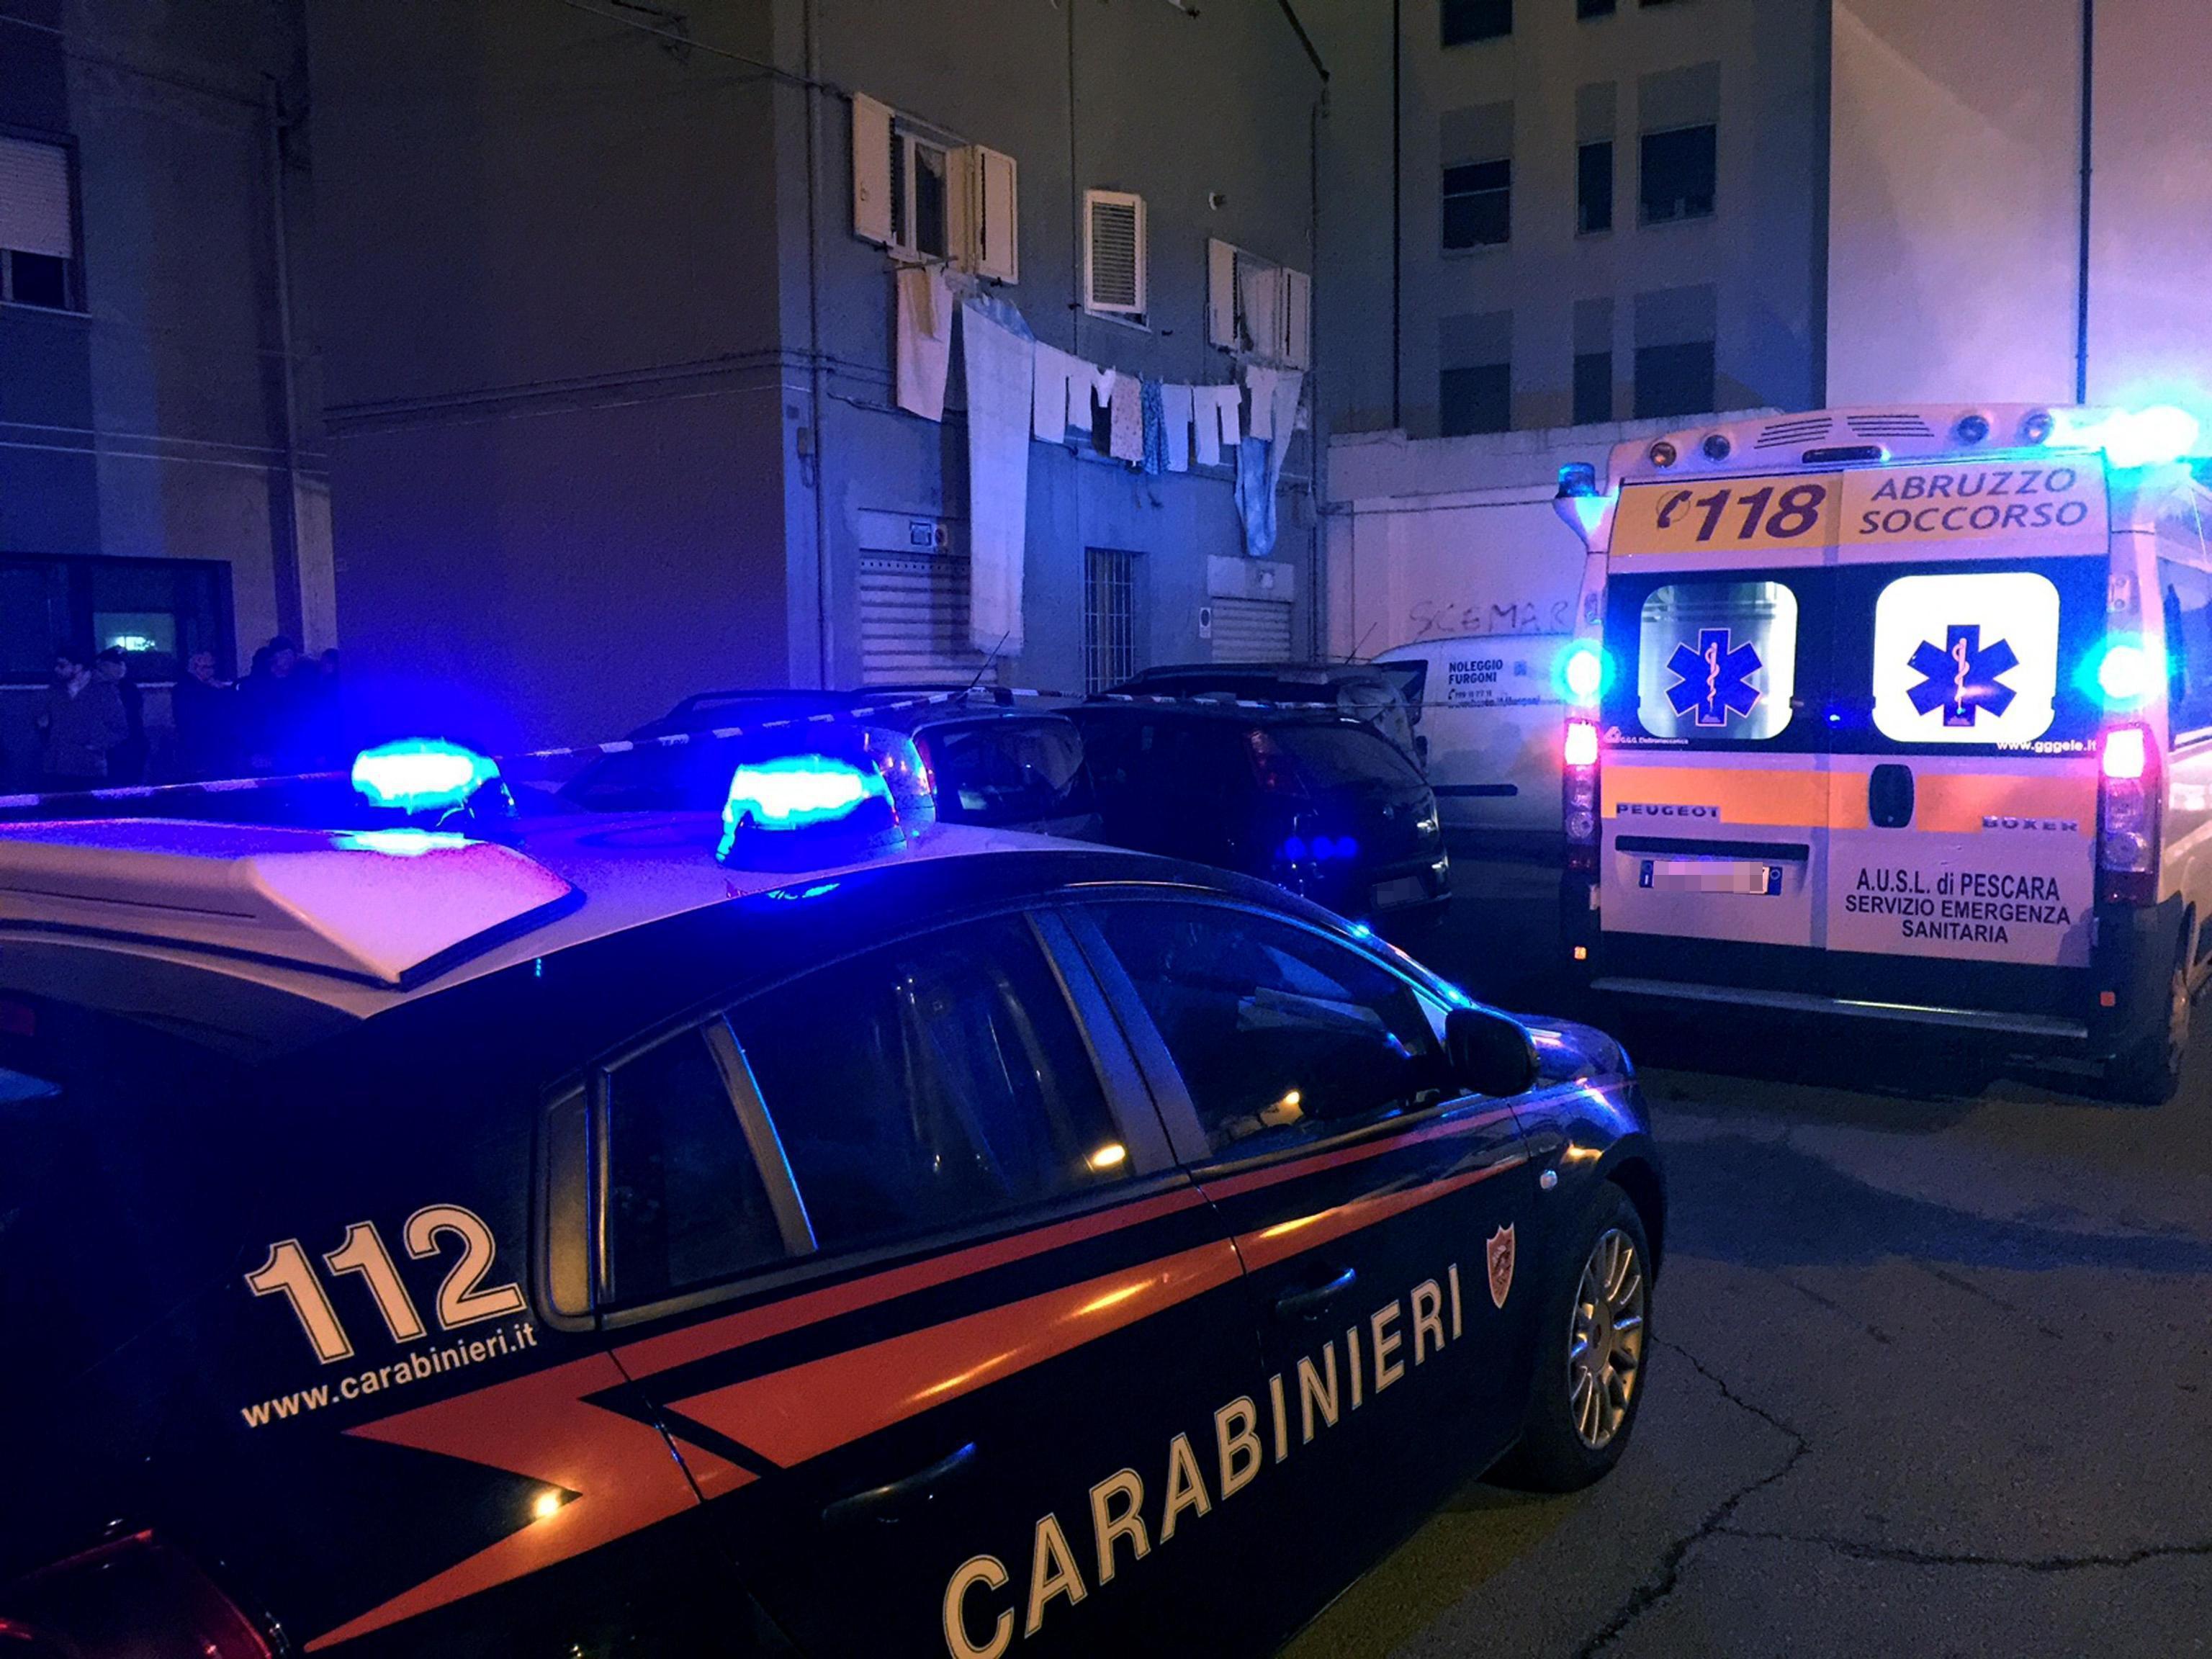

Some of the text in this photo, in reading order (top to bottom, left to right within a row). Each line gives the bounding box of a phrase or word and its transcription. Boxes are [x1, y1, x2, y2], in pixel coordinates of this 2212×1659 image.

[1871, 467, 2077, 502] ABRUZZO
[1695, 483, 1827, 542] 118
[1858, 501, 2088, 535] SOCCORSO
[1448, 672, 1497, 685] FURGONI
[1449, 659, 1503, 673] NOLEGGIO
[1617, 804, 1719, 818] PEUGEOT
[1982, 816, 2078, 832] BOXER
[1856, 868, 2061, 901] A.U.S.L. di PESCARA
[1845, 894, 2072, 925] SERVIZIO EMERGENZA
[1902, 919, 2009, 944] SANITARIA
[244, 1202, 528, 1366] 112
[240, 1321, 538, 1429] www.carabinieri.it
[942, 1262, 1464, 1659] CARABINIERI
